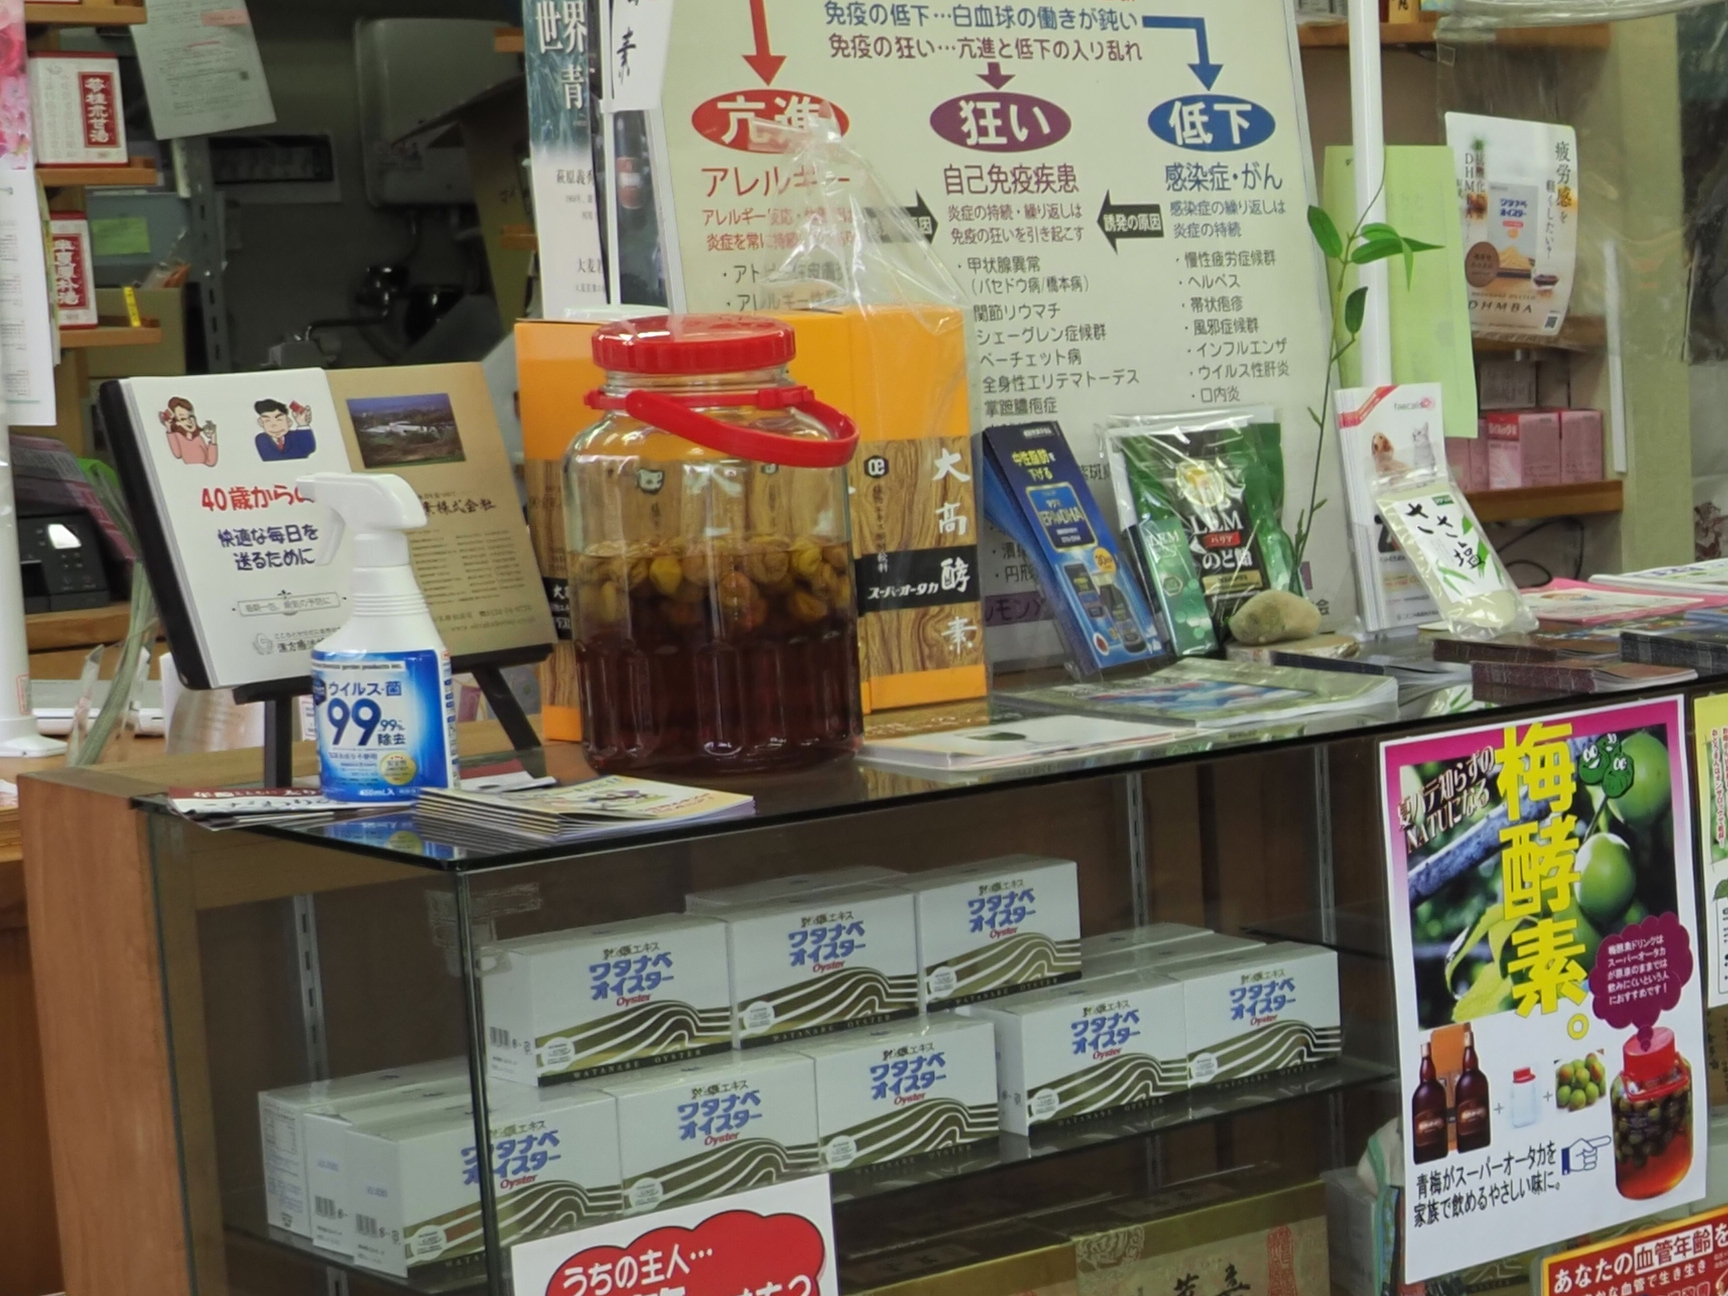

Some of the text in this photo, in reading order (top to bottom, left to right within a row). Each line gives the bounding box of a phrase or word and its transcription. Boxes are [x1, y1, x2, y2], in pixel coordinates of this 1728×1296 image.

[715, 94, 822, 146] 亢進
[960, 98, 1052, 146] 狂い
[1168, 99, 1254, 146] 低下
[700, 164, 852, 201] アレルギー
[942, 162, 1082, 198] 自己免疫疾患
[1163, 161, 1285, 193] 感染症・がん
[946, 200, 1085, 225] 炎症の持続・繰り返しは
[1169, 198, 1287, 219] 感染症の繰り返しは
[1104, 212, 1163, 235] 誘発の原因
[1172, 220, 1243, 241] 炎症の持続
[949, 223, 1086, 247] 免疫の狂いを引き起こす
[966, 254, 1042, 275] 甲状腺異常
[1184, 248, 1278, 270] 慢性疲労症候群
[1187, 271, 1242, 290] ヘルペス
[972, 301, 1063, 322] 関節リウマチ
[1189, 295, 1244, 315] 帯状疱疹
[1467, 298, 1534, 315] DHMBA
[975, 324, 1108, 347] シェーグレン症候群
[1193, 316, 1261, 337] 風邪症候群
[979, 349, 1084, 368] ベーチェット病
[1195, 337, 1290, 359] インフルエンザ
[982, 369, 1141, 395] 全身性エリテマトーデス
[1197, 360, 1291, 382] ウイルス性肝炎
[1199, 384, 1242, 405] 口内炎
[217, 523, 319, 549] 快適な毎日を
[233, 547, 316, 572] 送るために
[1201, 549, 1253, 570] のど飴
[377, 733, 407, 746] 除去
[1415, 1138, 1558, 1200] 青梅がスーパーオータカを
